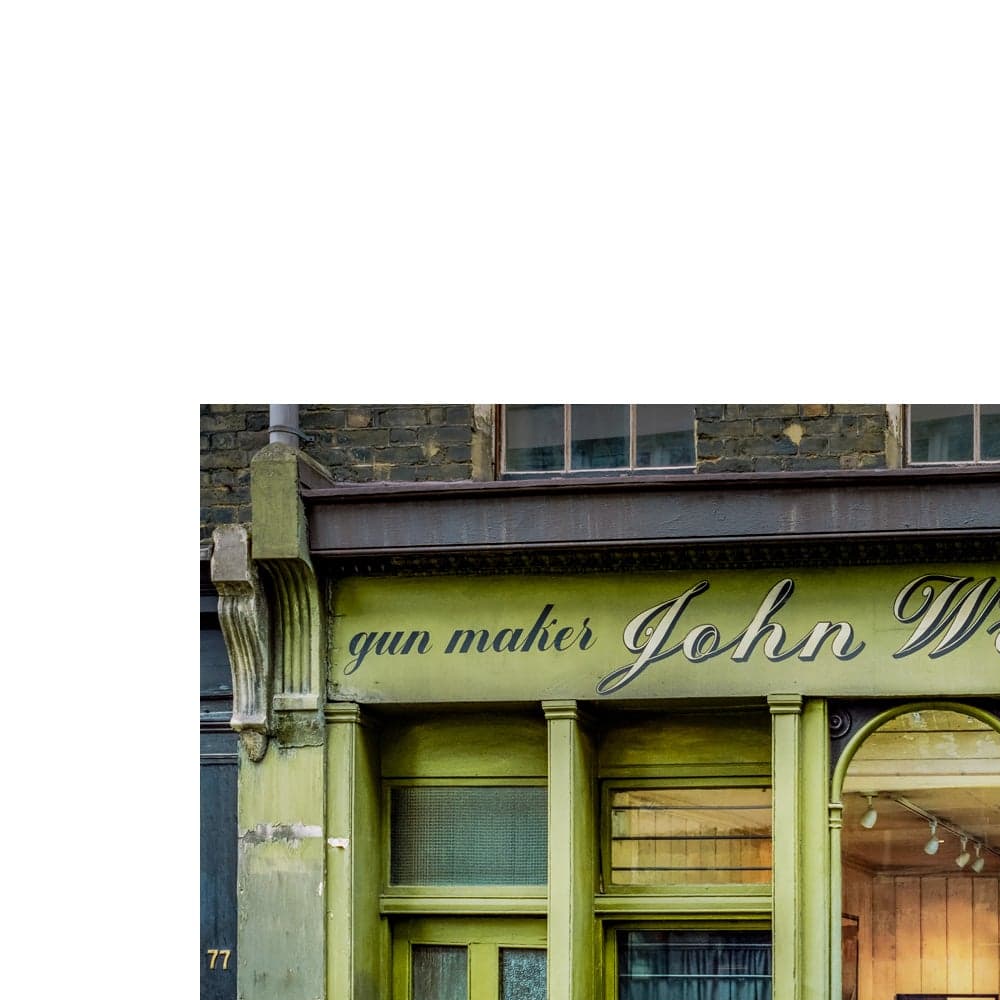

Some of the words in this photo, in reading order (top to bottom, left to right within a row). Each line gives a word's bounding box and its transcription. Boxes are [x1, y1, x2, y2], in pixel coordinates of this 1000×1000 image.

[343, 629, 432, 676] gun
[444, 603, 597, 654] maker
[596, 578, 866, 696] John
[207, 949, 231, 970] 77
